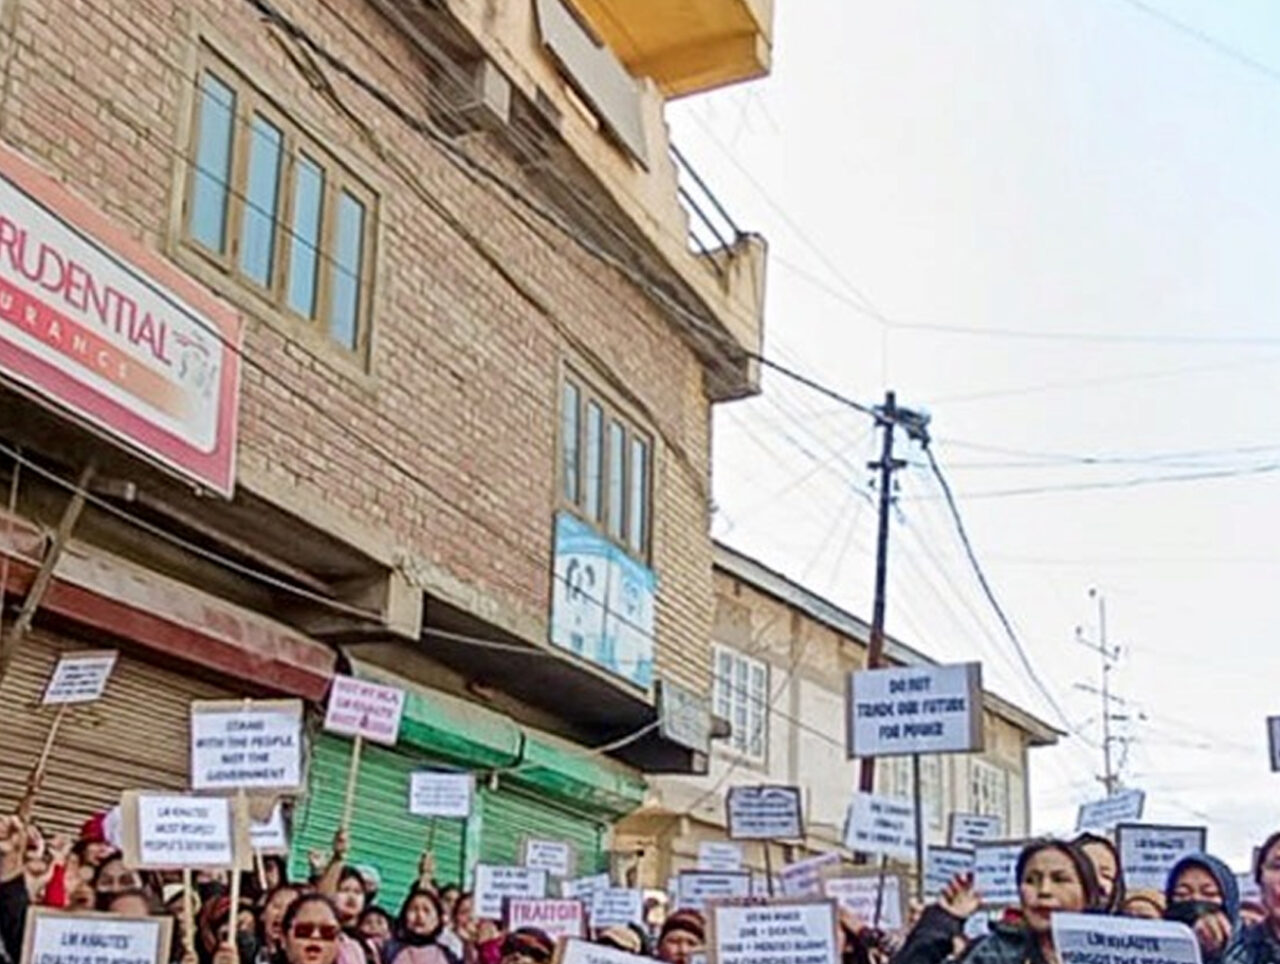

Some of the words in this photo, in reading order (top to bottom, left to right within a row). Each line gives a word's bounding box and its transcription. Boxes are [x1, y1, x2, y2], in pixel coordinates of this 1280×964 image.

[228, 736, 247, 747] THE
[248, 752, 270, 763] THE
[206, 768, 286, 782] GOVERNMENT
[512, 904, 579, 923] TRAITOR
